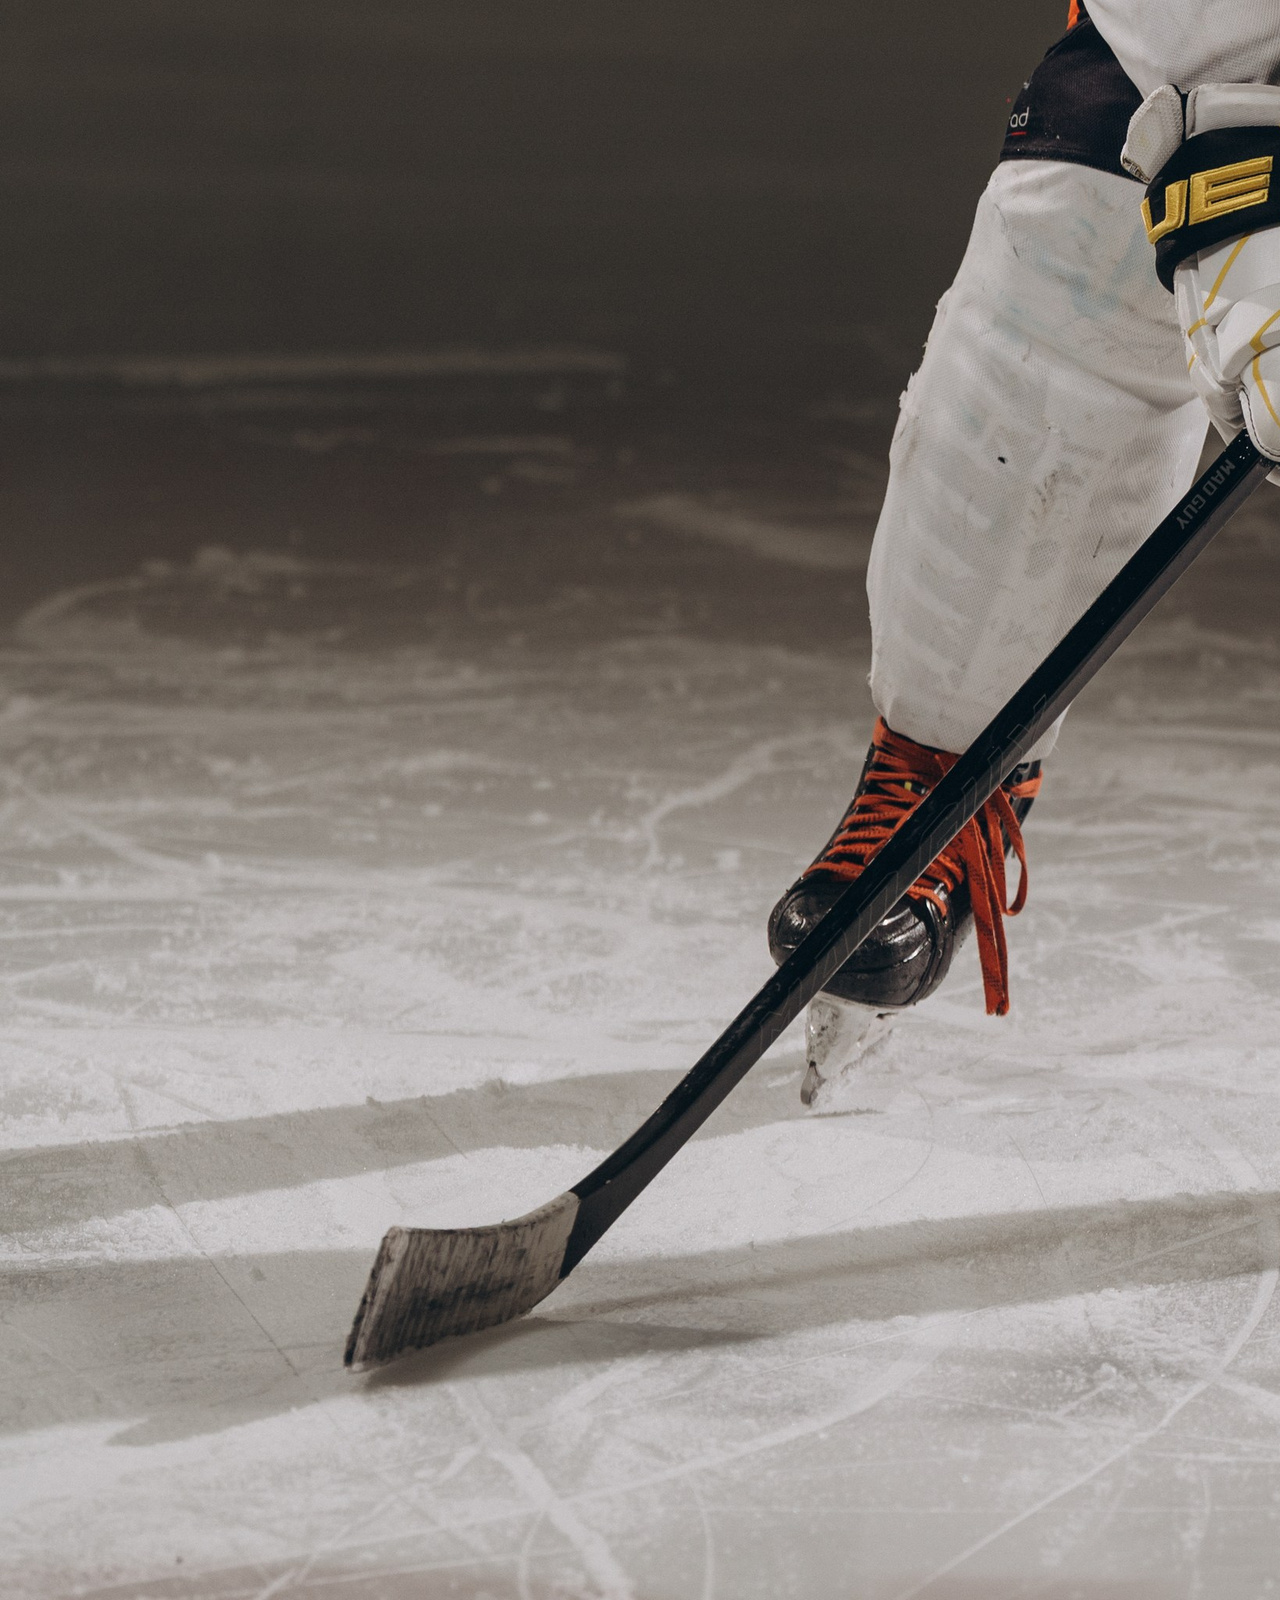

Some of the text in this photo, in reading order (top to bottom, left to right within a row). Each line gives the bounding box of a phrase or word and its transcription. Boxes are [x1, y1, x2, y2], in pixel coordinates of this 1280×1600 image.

[1140, 155, 1274, 245] UE
[1176, 459, 1236, 530] MAD GUY
